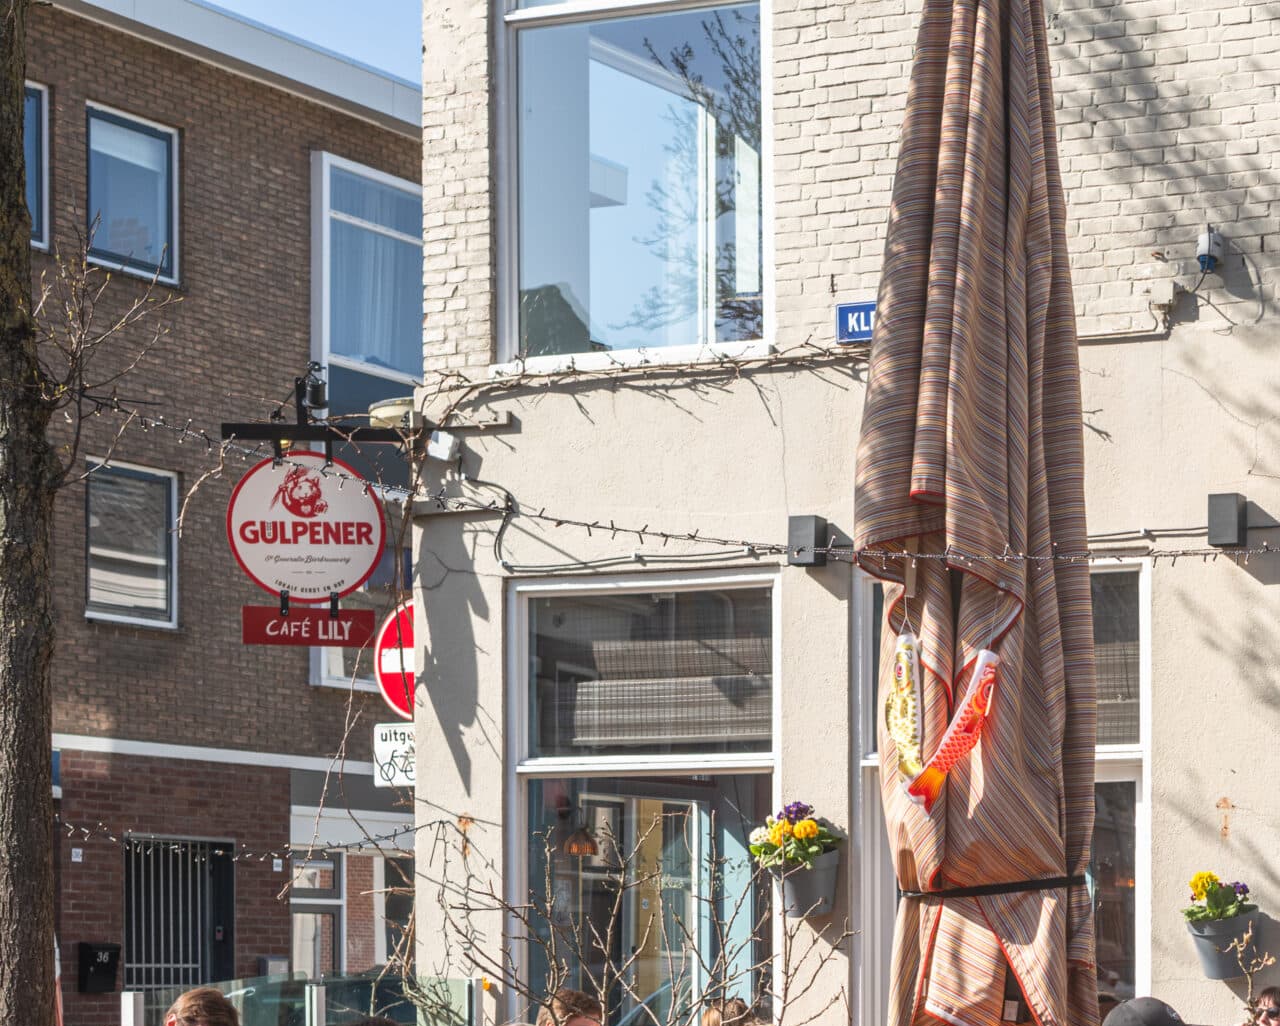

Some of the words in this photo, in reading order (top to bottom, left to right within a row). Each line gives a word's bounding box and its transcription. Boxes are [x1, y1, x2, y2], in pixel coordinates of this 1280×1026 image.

[239, 520, 374, 545] GULPENER
[265, 616, 310, 638] CAFÉ
[318, 620, 353, 641] LILY
[96, 951, 109, 963] 36
